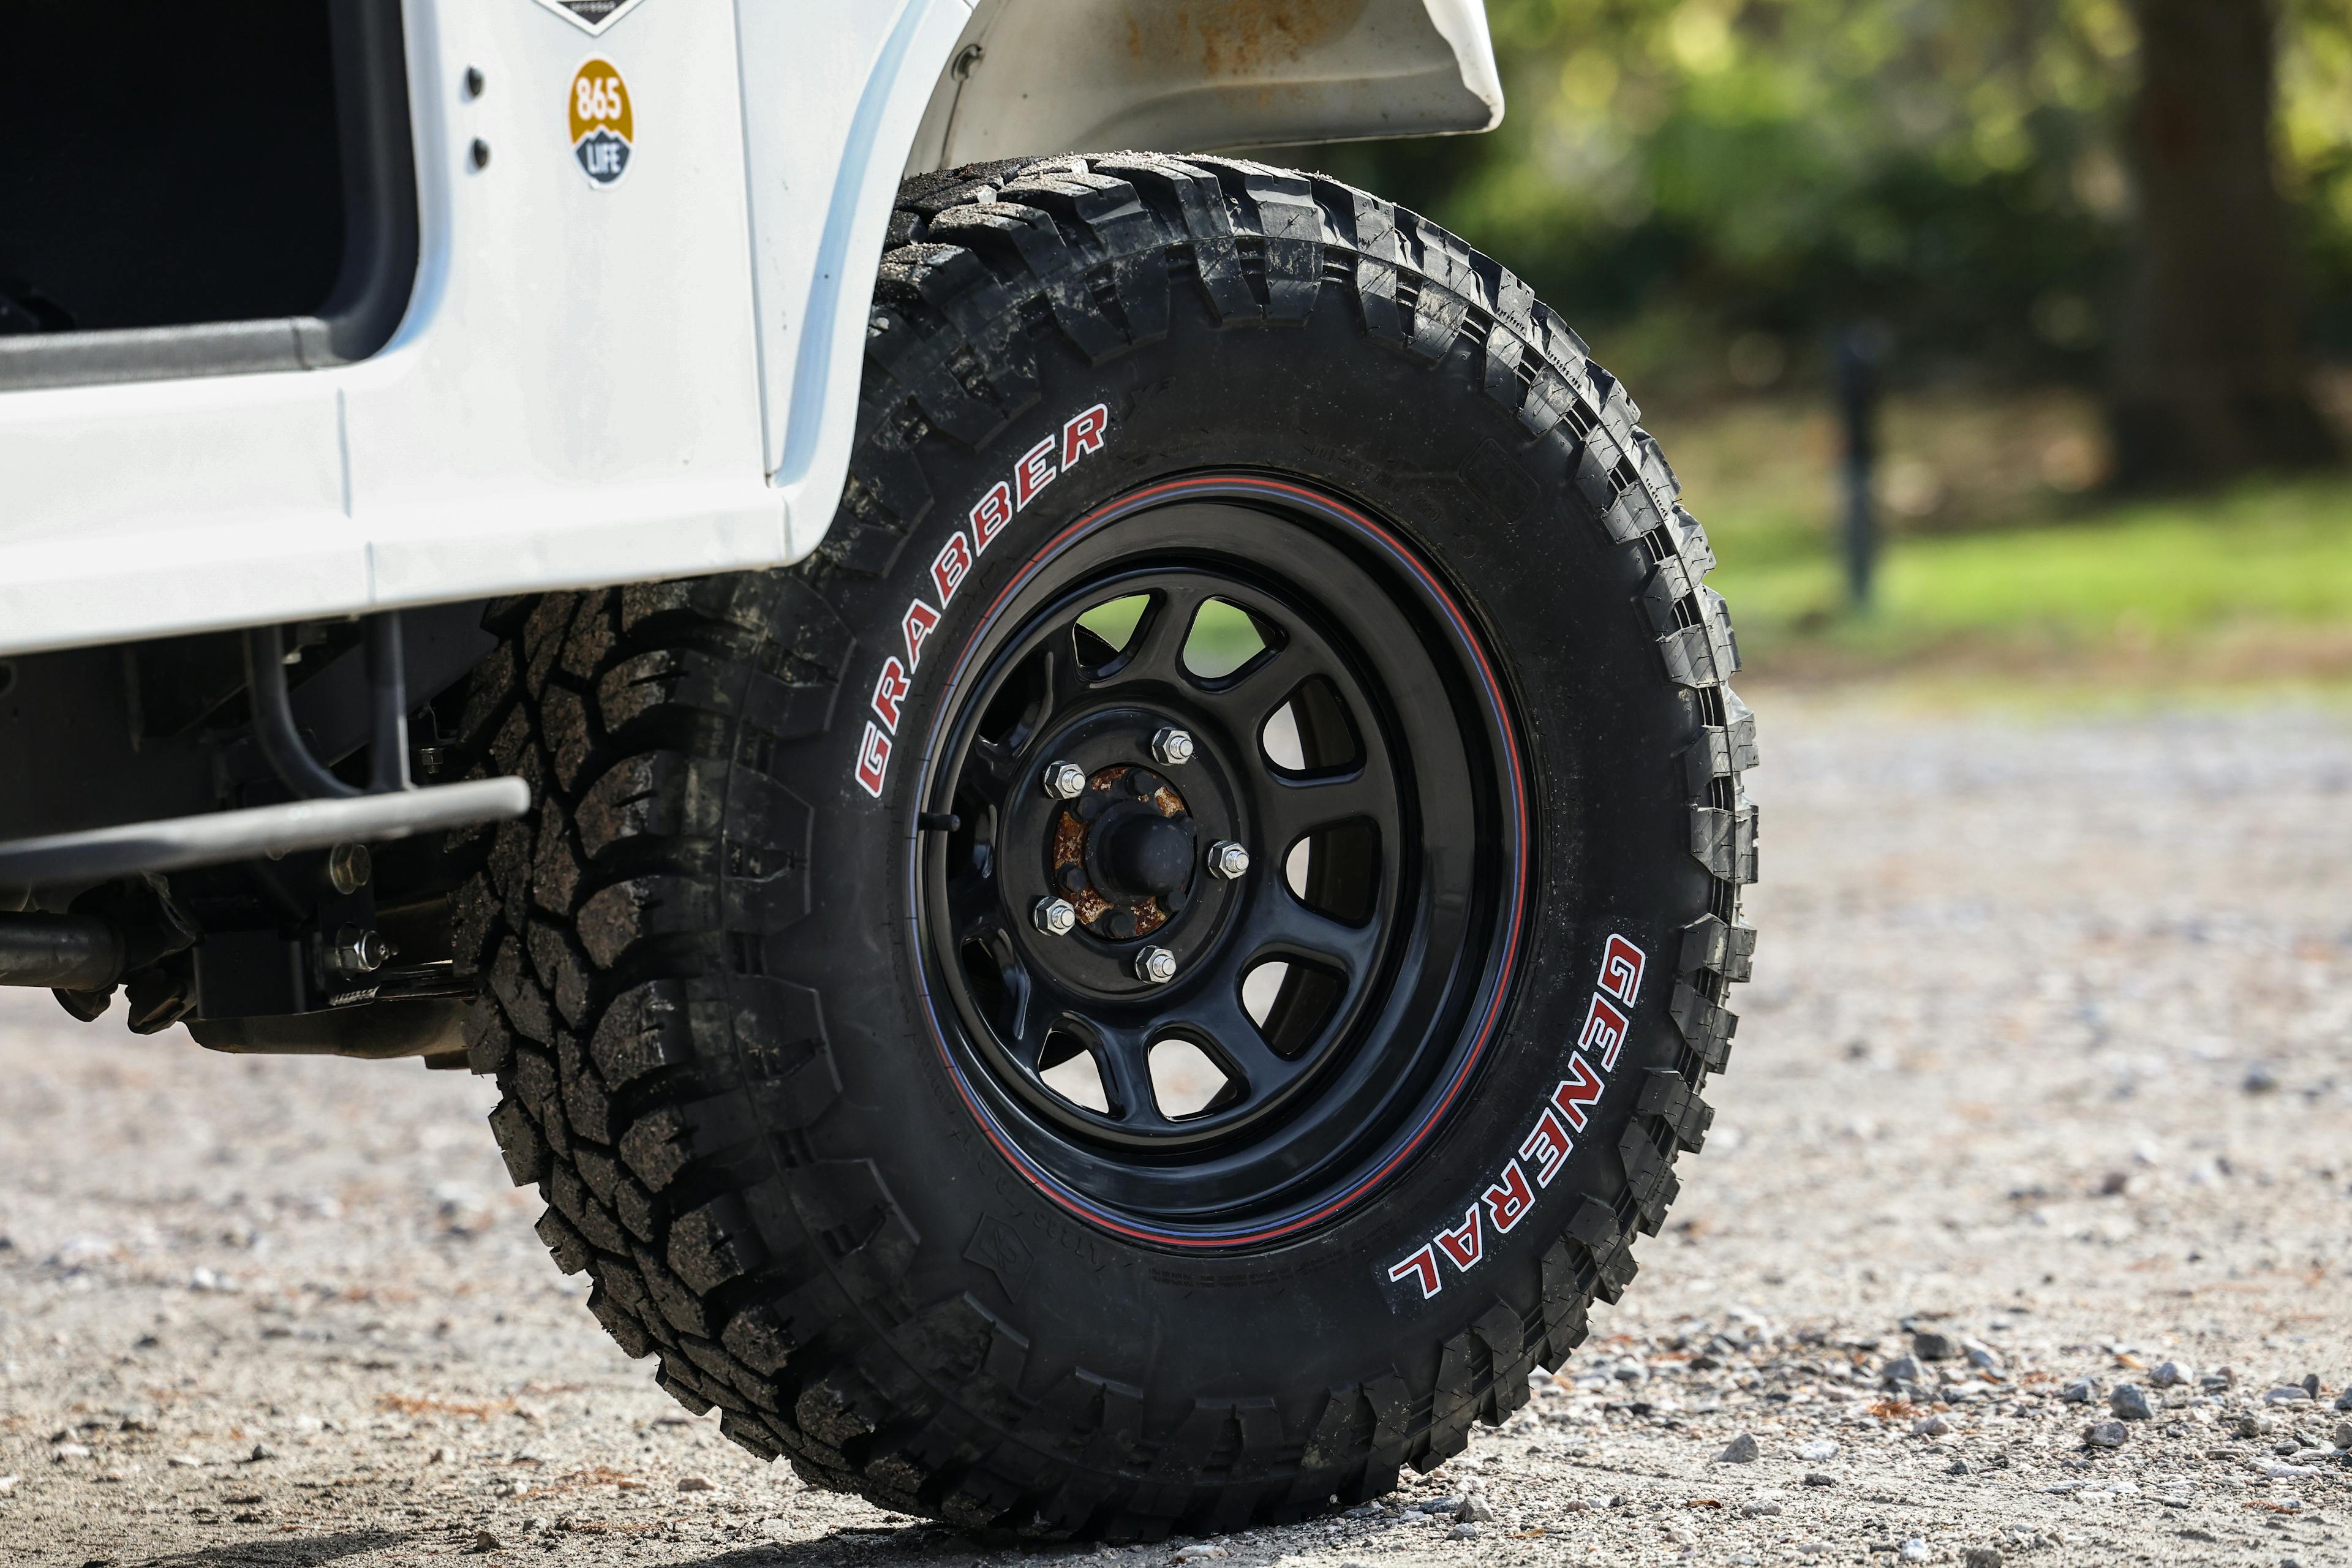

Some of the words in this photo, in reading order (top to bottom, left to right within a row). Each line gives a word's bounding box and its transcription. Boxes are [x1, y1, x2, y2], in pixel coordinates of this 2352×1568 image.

[576, 77, 622, 121] 865
[586, 142, 622, 174] LIFE
[855, 403, 1108, 797] GRABBER
[1388, 933, 1645, 1299] GENERAL
